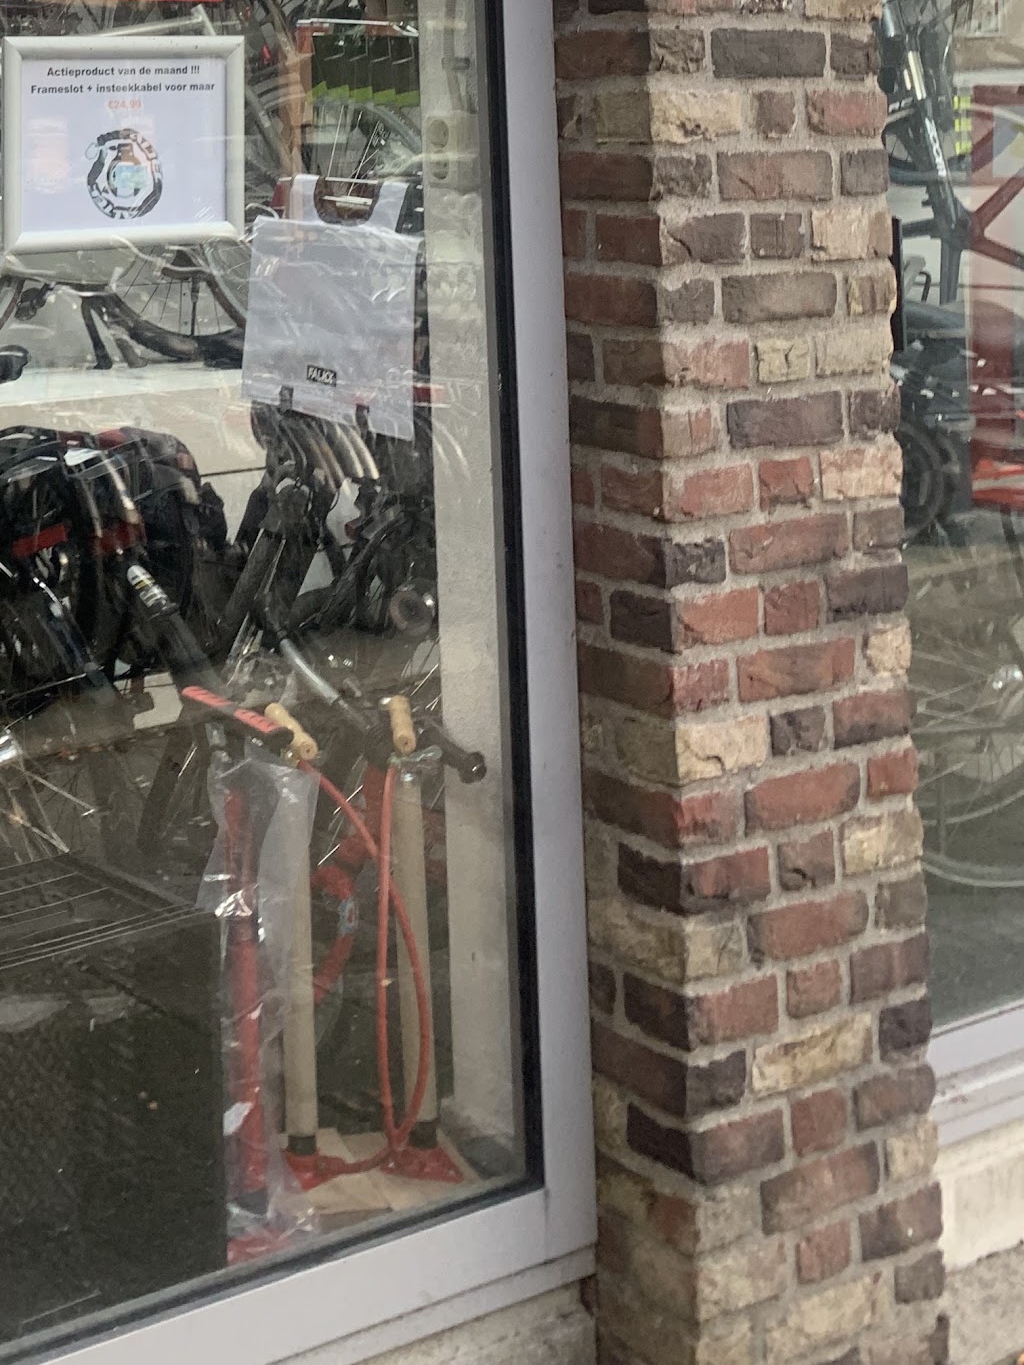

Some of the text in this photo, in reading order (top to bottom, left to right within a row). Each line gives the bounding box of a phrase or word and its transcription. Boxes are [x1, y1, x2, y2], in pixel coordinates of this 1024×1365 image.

[47, 66, 115, 78] Actieproduct
[118, 68, 136, 76] van
[139, 66, 151, 75] de
[154, 66, 188, 75] maand
[30, 84, 84, 95] Frameslot
[96, 83, 162, 93] insteekkabel
[164, 84, 187, 92] voor
[189, 83, 215, 91] maar
